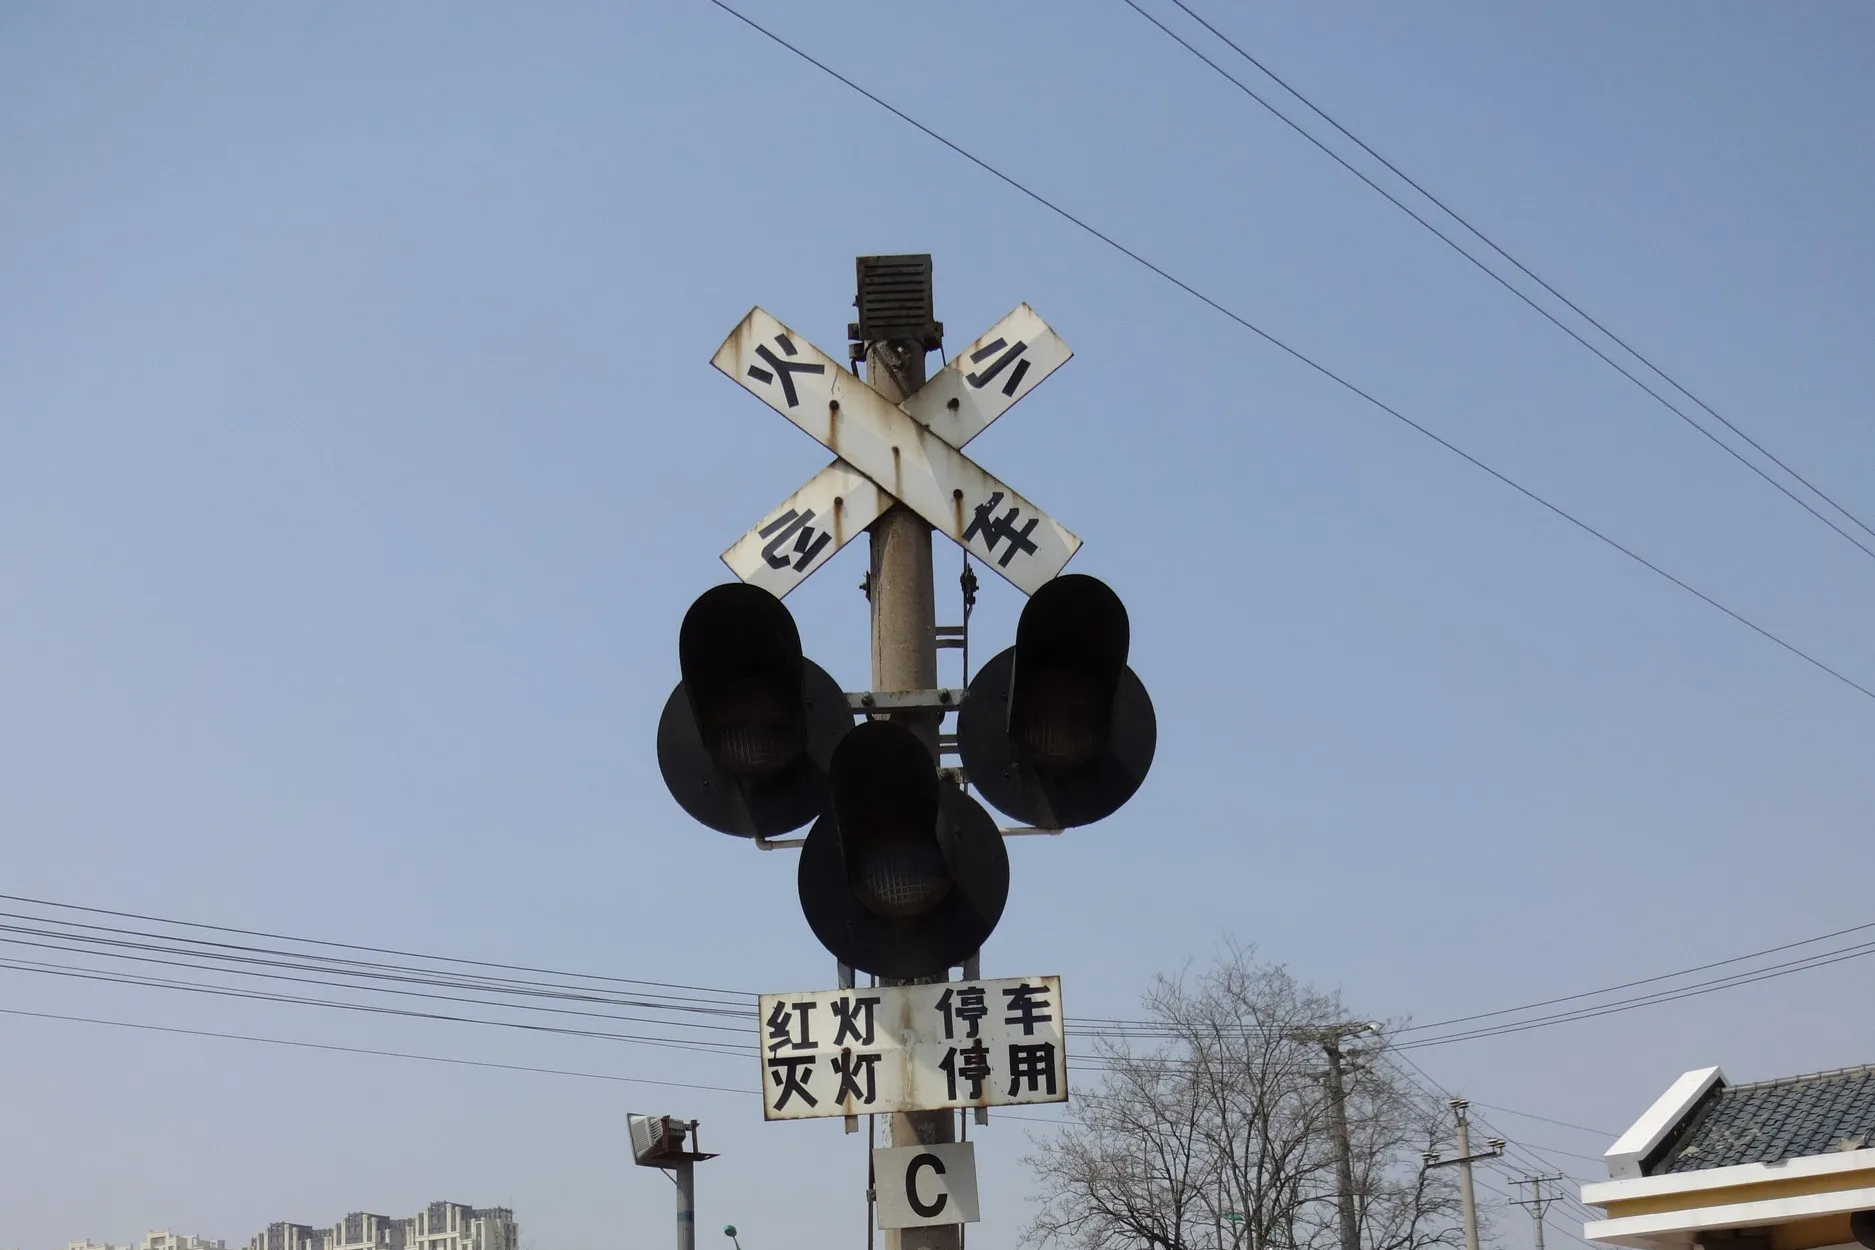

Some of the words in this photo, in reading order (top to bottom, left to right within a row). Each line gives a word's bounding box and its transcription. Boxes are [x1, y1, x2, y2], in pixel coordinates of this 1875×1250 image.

[965, 337, 1031, 398] 小
[747, 332, 825, 409] 火
[962, 491, 1039, 569] 车
[758, 508, 832, 572] 心
[766, 996, 881, 1052] 红灯
[935, 983, 1052, 1039] 停车
[768, 1053, 882, 1111] 灭灯
[938, 1041, 1057, 1101] 停用
[905, 1153, 948, 1218] C
